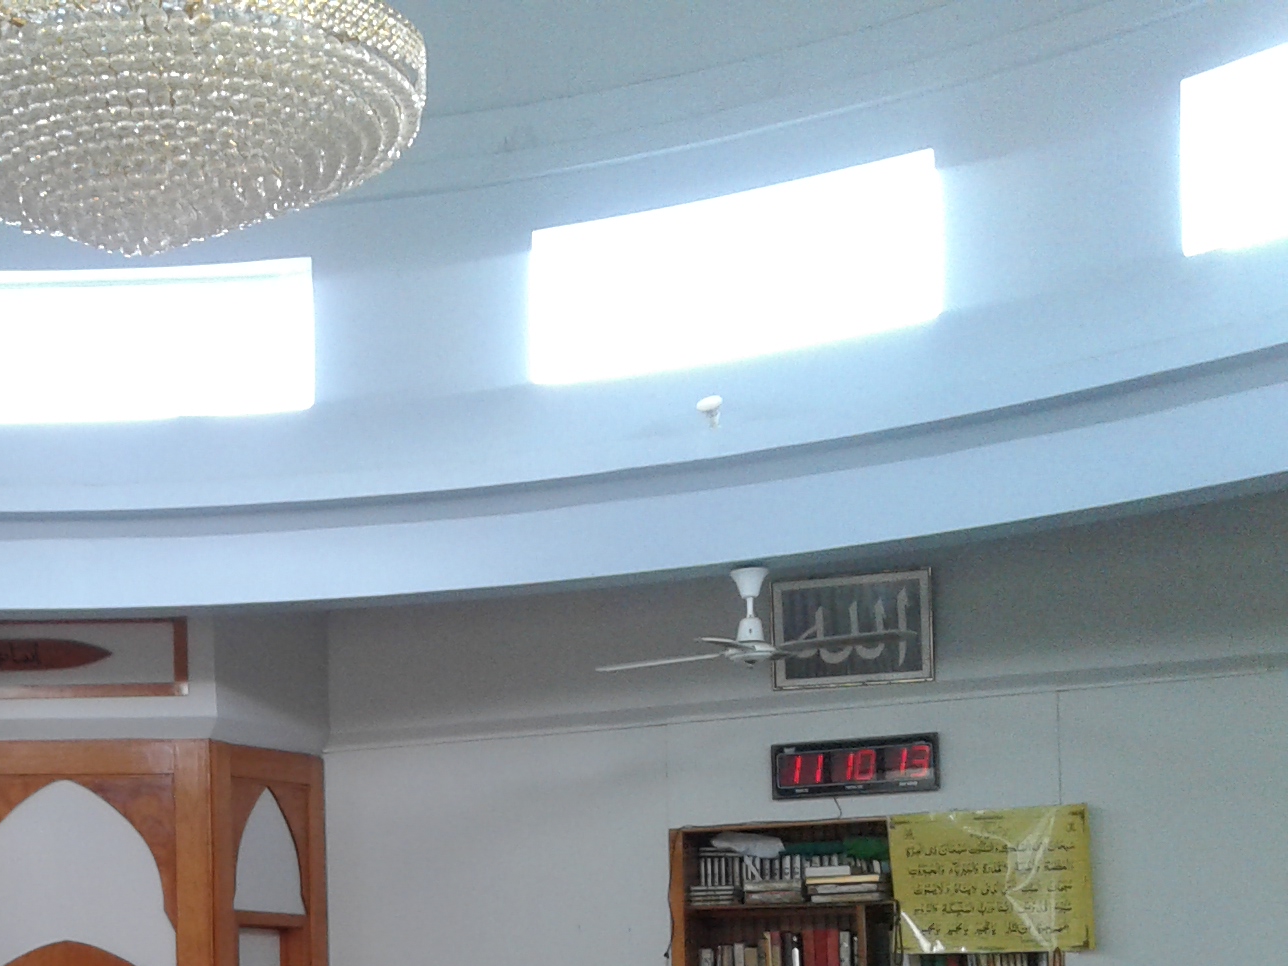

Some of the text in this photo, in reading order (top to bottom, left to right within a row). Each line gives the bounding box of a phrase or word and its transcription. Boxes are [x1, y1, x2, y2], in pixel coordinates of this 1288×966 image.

[793, 745, 931, 784] 11 10 13
